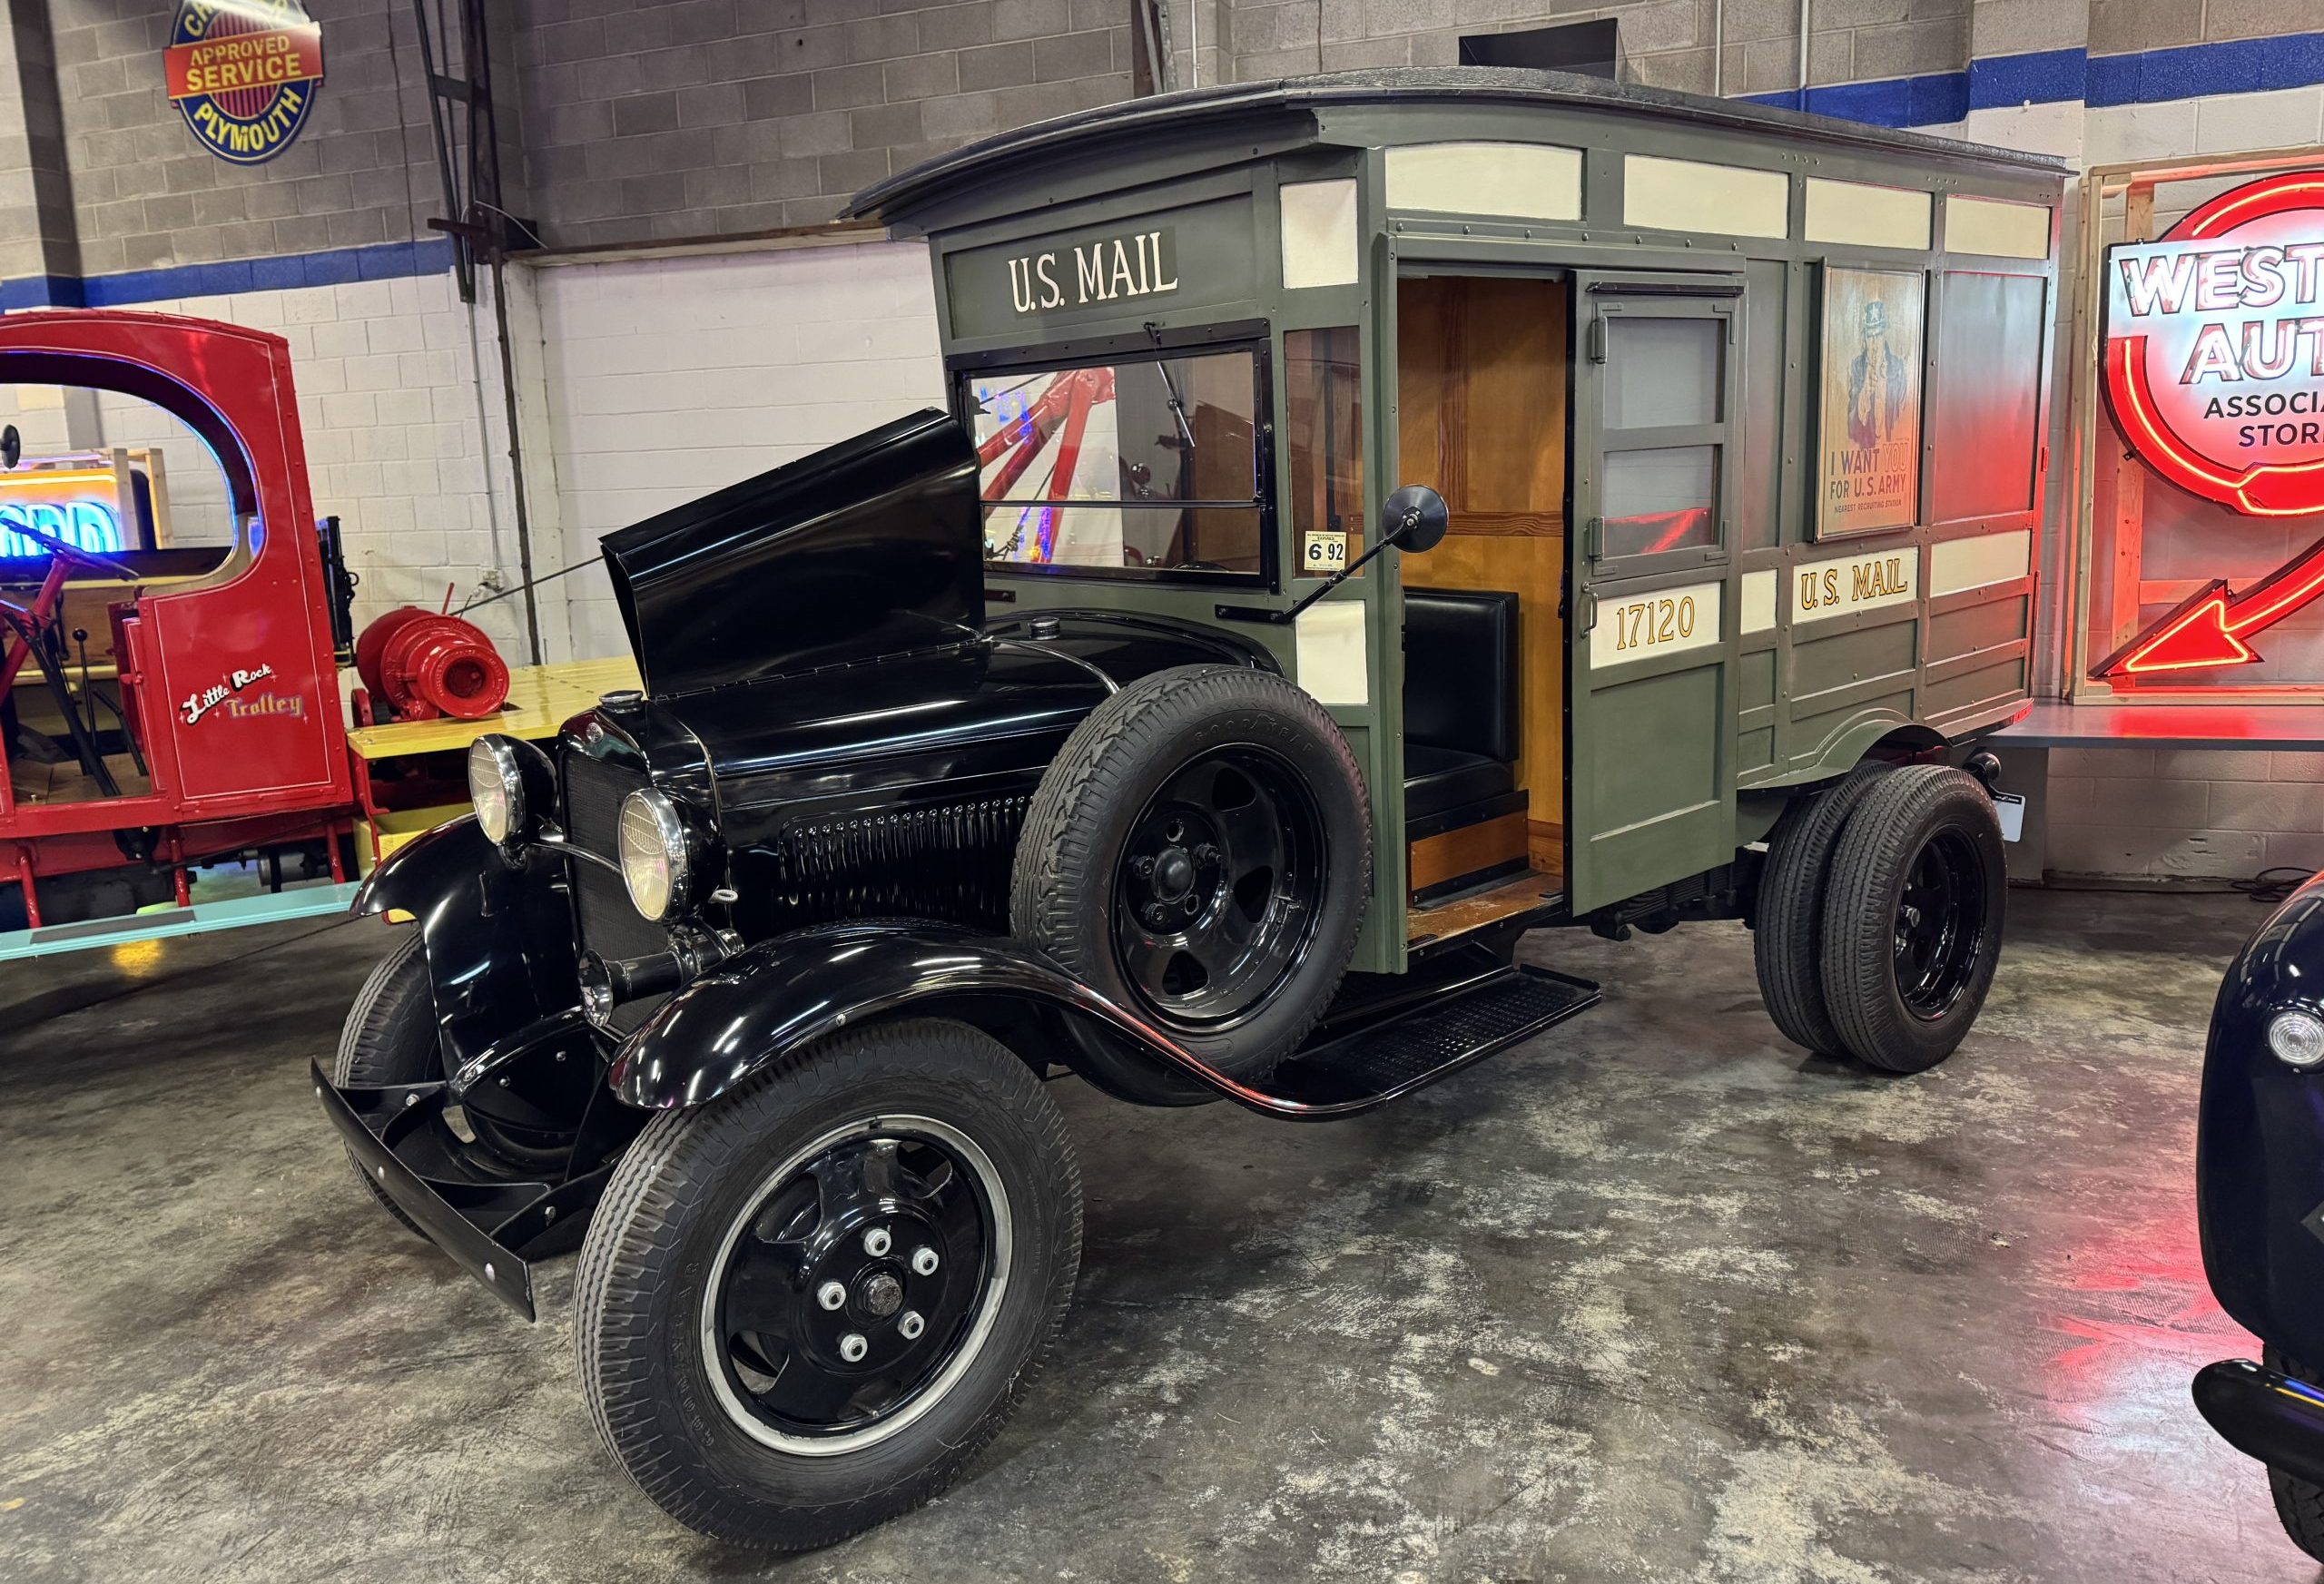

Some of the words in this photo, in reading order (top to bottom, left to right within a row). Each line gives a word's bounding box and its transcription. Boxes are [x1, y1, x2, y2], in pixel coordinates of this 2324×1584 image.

[191, 35, 290, 66] APPROVED
[186, 53, 302, 91] SERVICE
[193, 87, 303, 152] PLYMOUTH
[1008, 252, 1066, 312] U.S.
[1074, 231, 1178, 303] MAIL
[2119, 242, 2324, 318] WEST
[2202, 391, 2324, 419] ASSOCI
[2239, 422, 2324, 448] STOR
[1830, 451, 1835, 476] I
[1841, 448, 1880, 475] WANT
[1883, 442, 1908, 472] YOU
[1830, 479, 1850, 500] FOR
[1834, 504, 1856, 514] NEAREST
[1857, 501, 1884, 510] RECRUITING
[1308, 543, 1322, 560] 6
[1328, 543, 1344, 561] 92
[1801, 568, 1840, 610] U.S.
[1851, 558, 1908, 601] MAIL
[1617, 595, 1695, 651] 17120
[181, 684, 230, 724] Little
[230, 663, 272, 692] Rock
[224, 692, 303, 718] Trolley
